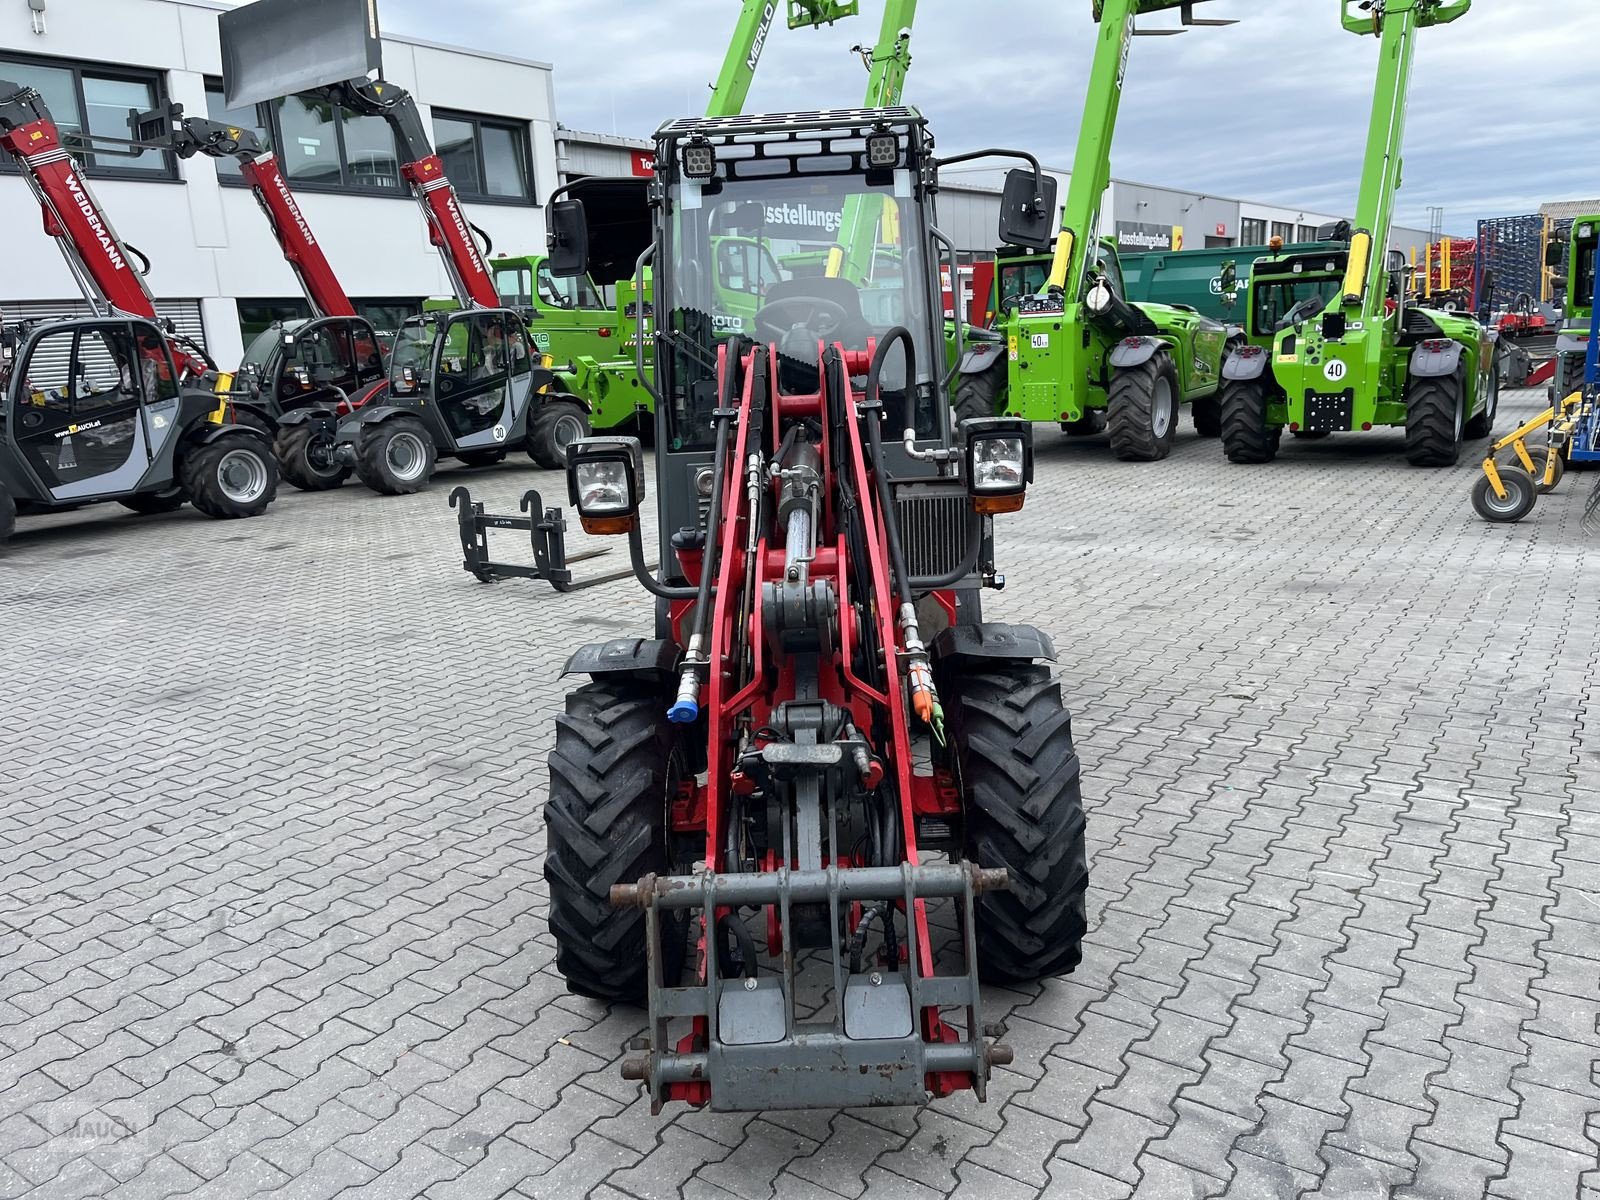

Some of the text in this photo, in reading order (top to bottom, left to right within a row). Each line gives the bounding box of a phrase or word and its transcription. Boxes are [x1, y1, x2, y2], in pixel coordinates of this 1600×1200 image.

[747, 3, 774, 70] MERLO
[65, 174, 125, 270] WEIDEMANN
[273, 174, 315, 246] WEIDEMANN
[764, 203, 844, 233] sstellungs
[446, 197, 483, 273] WEIDEMANN
[1118, 230, 1169, 250] Ausstellungshalle
[1315, 321, 1363, 332] MLO
[1032, 335, 1042, 347] 40
[1327, 363, 1343, 377] 40
[495, 427, 504, 439] 30
